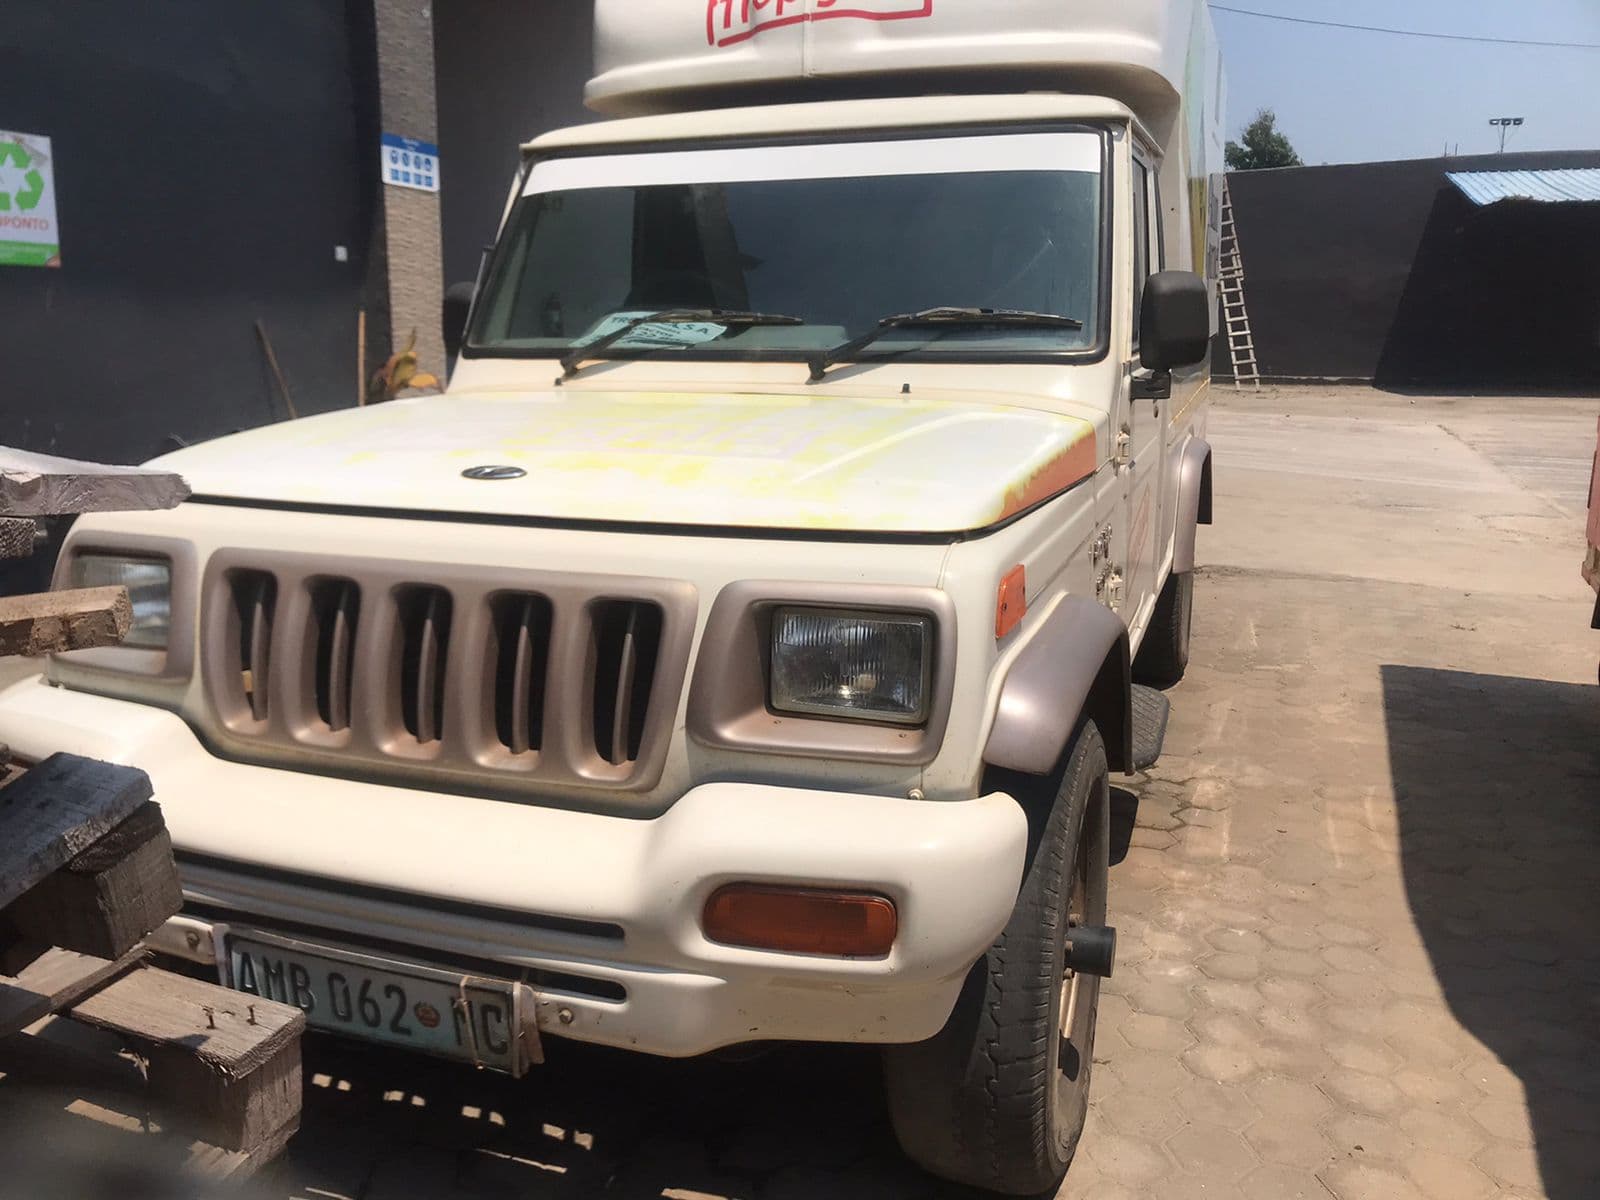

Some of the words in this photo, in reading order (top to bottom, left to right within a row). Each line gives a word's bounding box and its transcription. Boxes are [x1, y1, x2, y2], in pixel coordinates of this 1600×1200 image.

[0, 215, 49, 231] PONTO
[238, 951, 315, 1014] AMB
[327, 972, 412, 1037] 062
